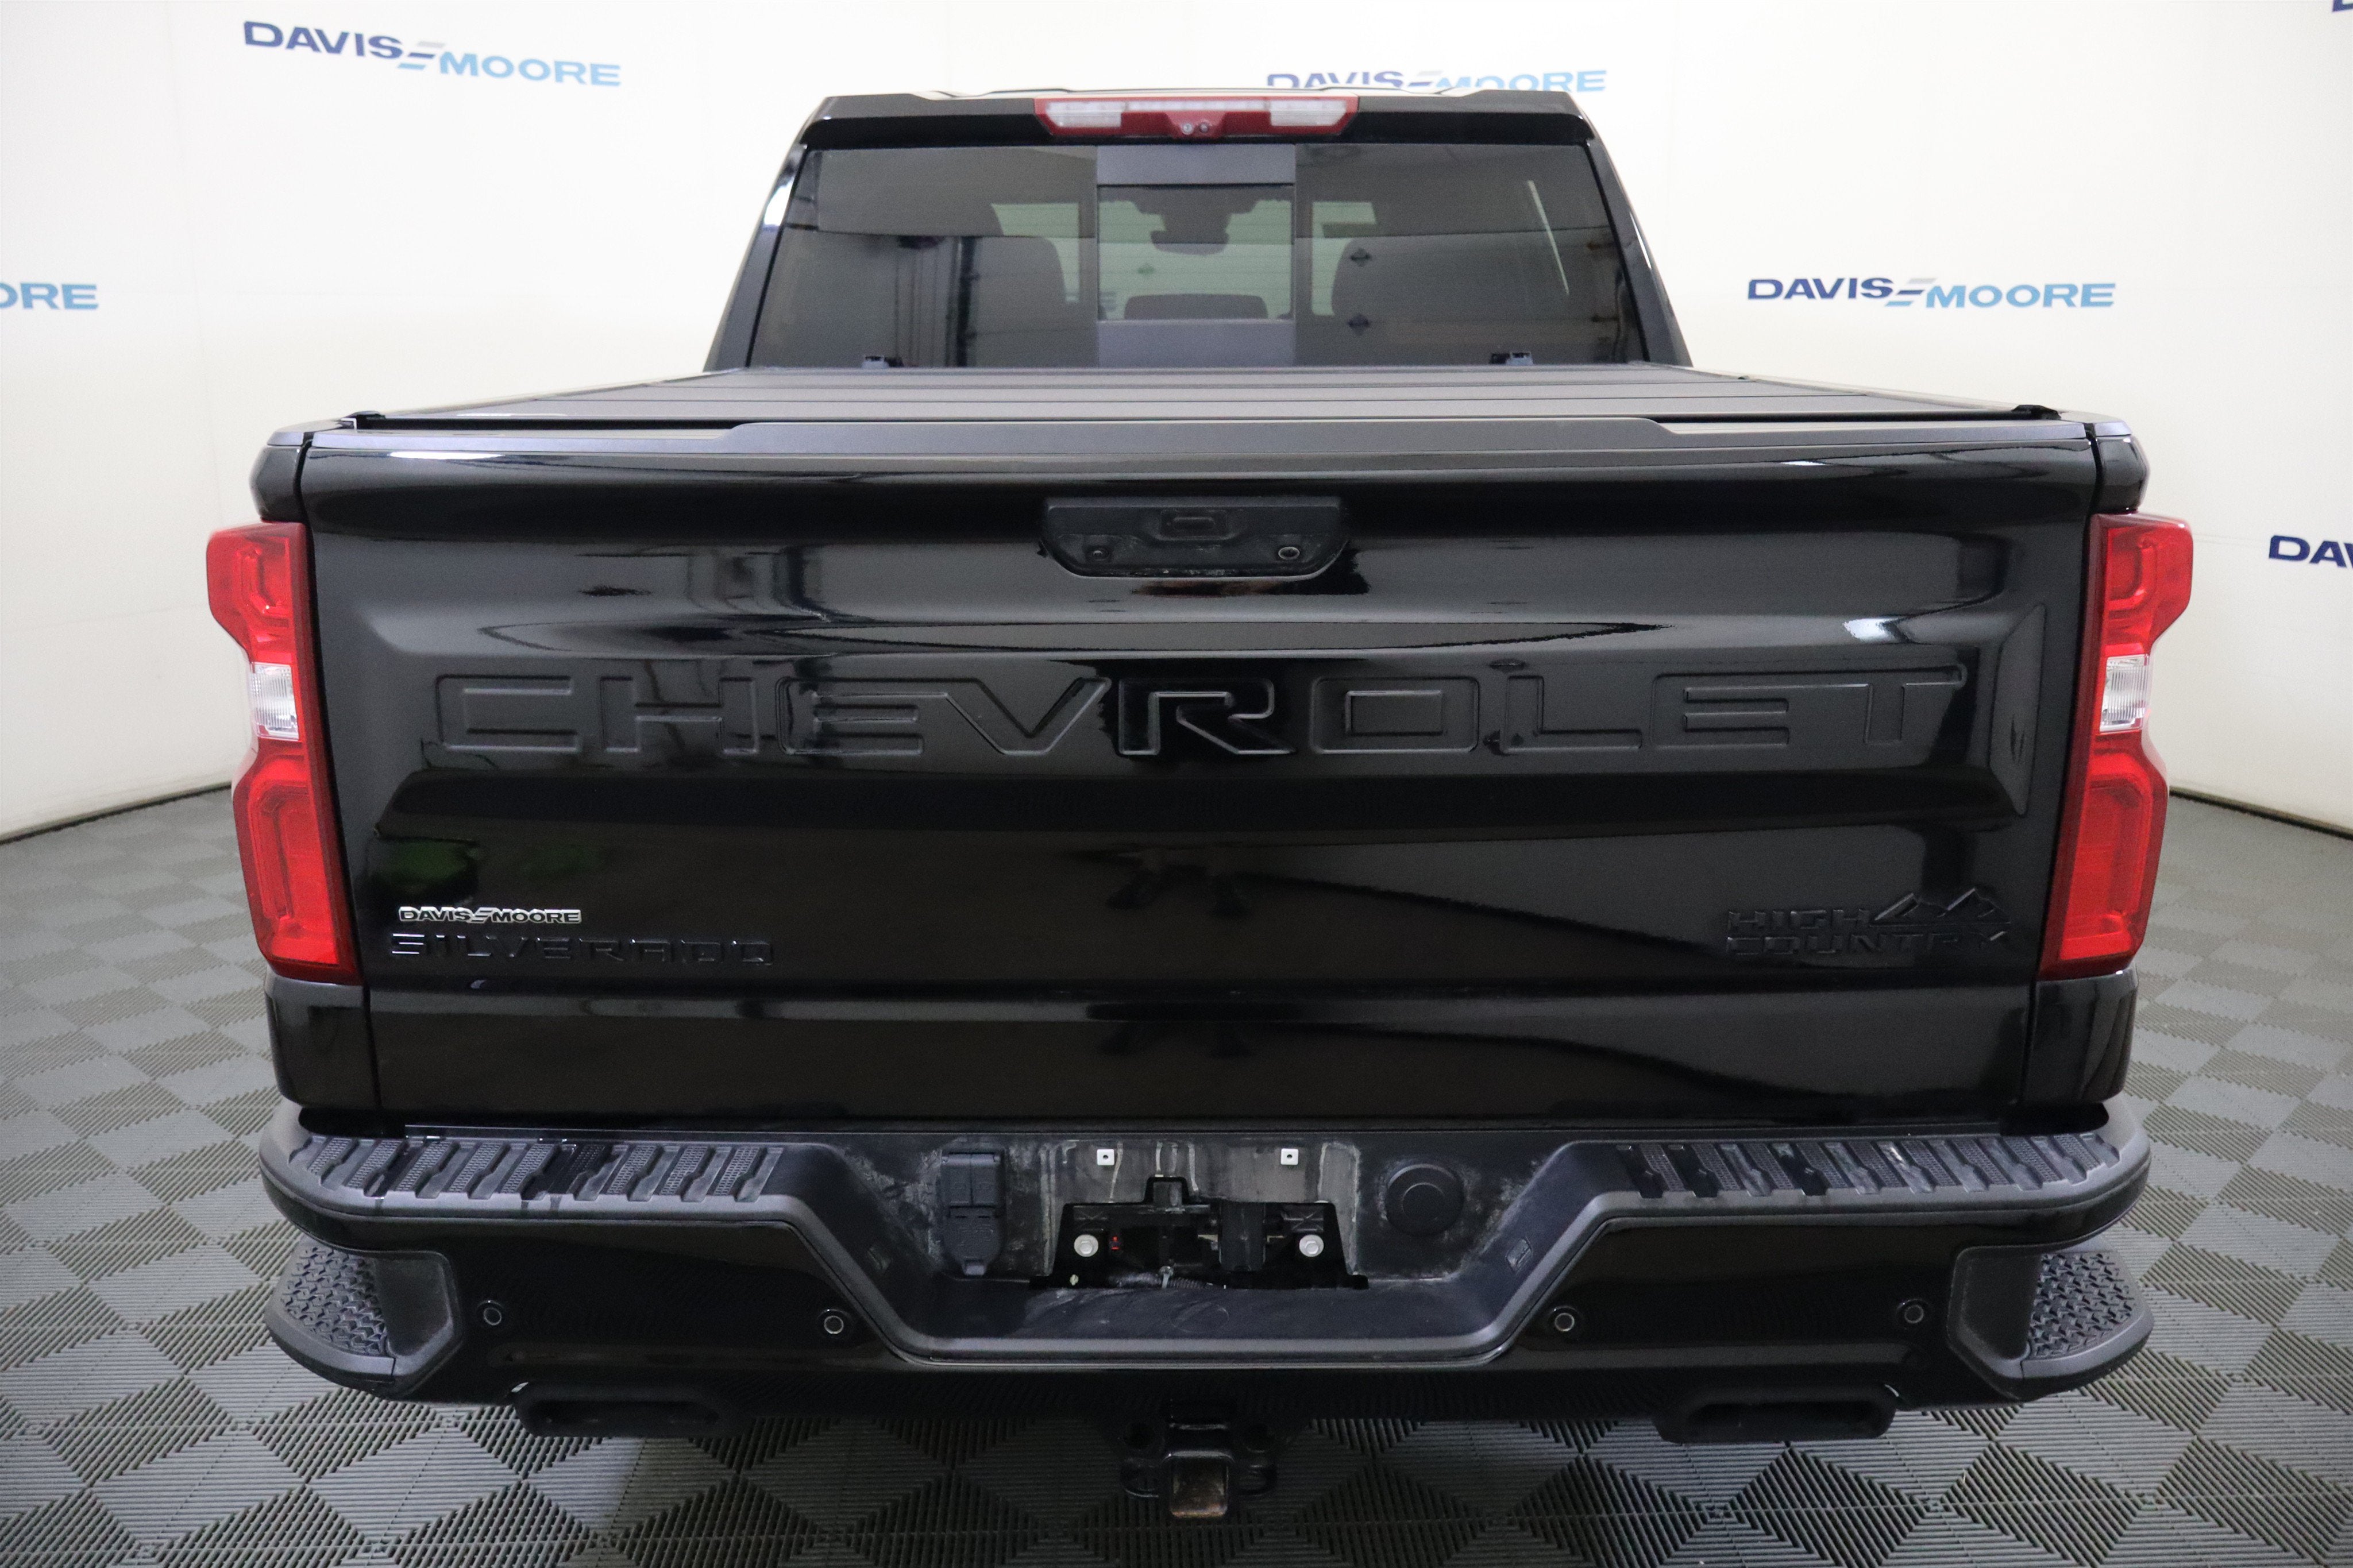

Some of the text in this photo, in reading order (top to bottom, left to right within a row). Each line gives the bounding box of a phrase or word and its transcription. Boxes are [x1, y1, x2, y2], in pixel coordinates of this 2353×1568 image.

[244, 21, 622, 87] DAVIS MOORE
[1267, 71, 1403, 88] DAVIS
[1748, 277, 2116, 308] DAVIS MOORE
[2269, 535, 2353, 568] DA
[435, 664, 1967, 757] CHEVROLET
[400, 907, 581, 923] DAVIS MOORE
[392, 933, 774, 966] SILVERADO
